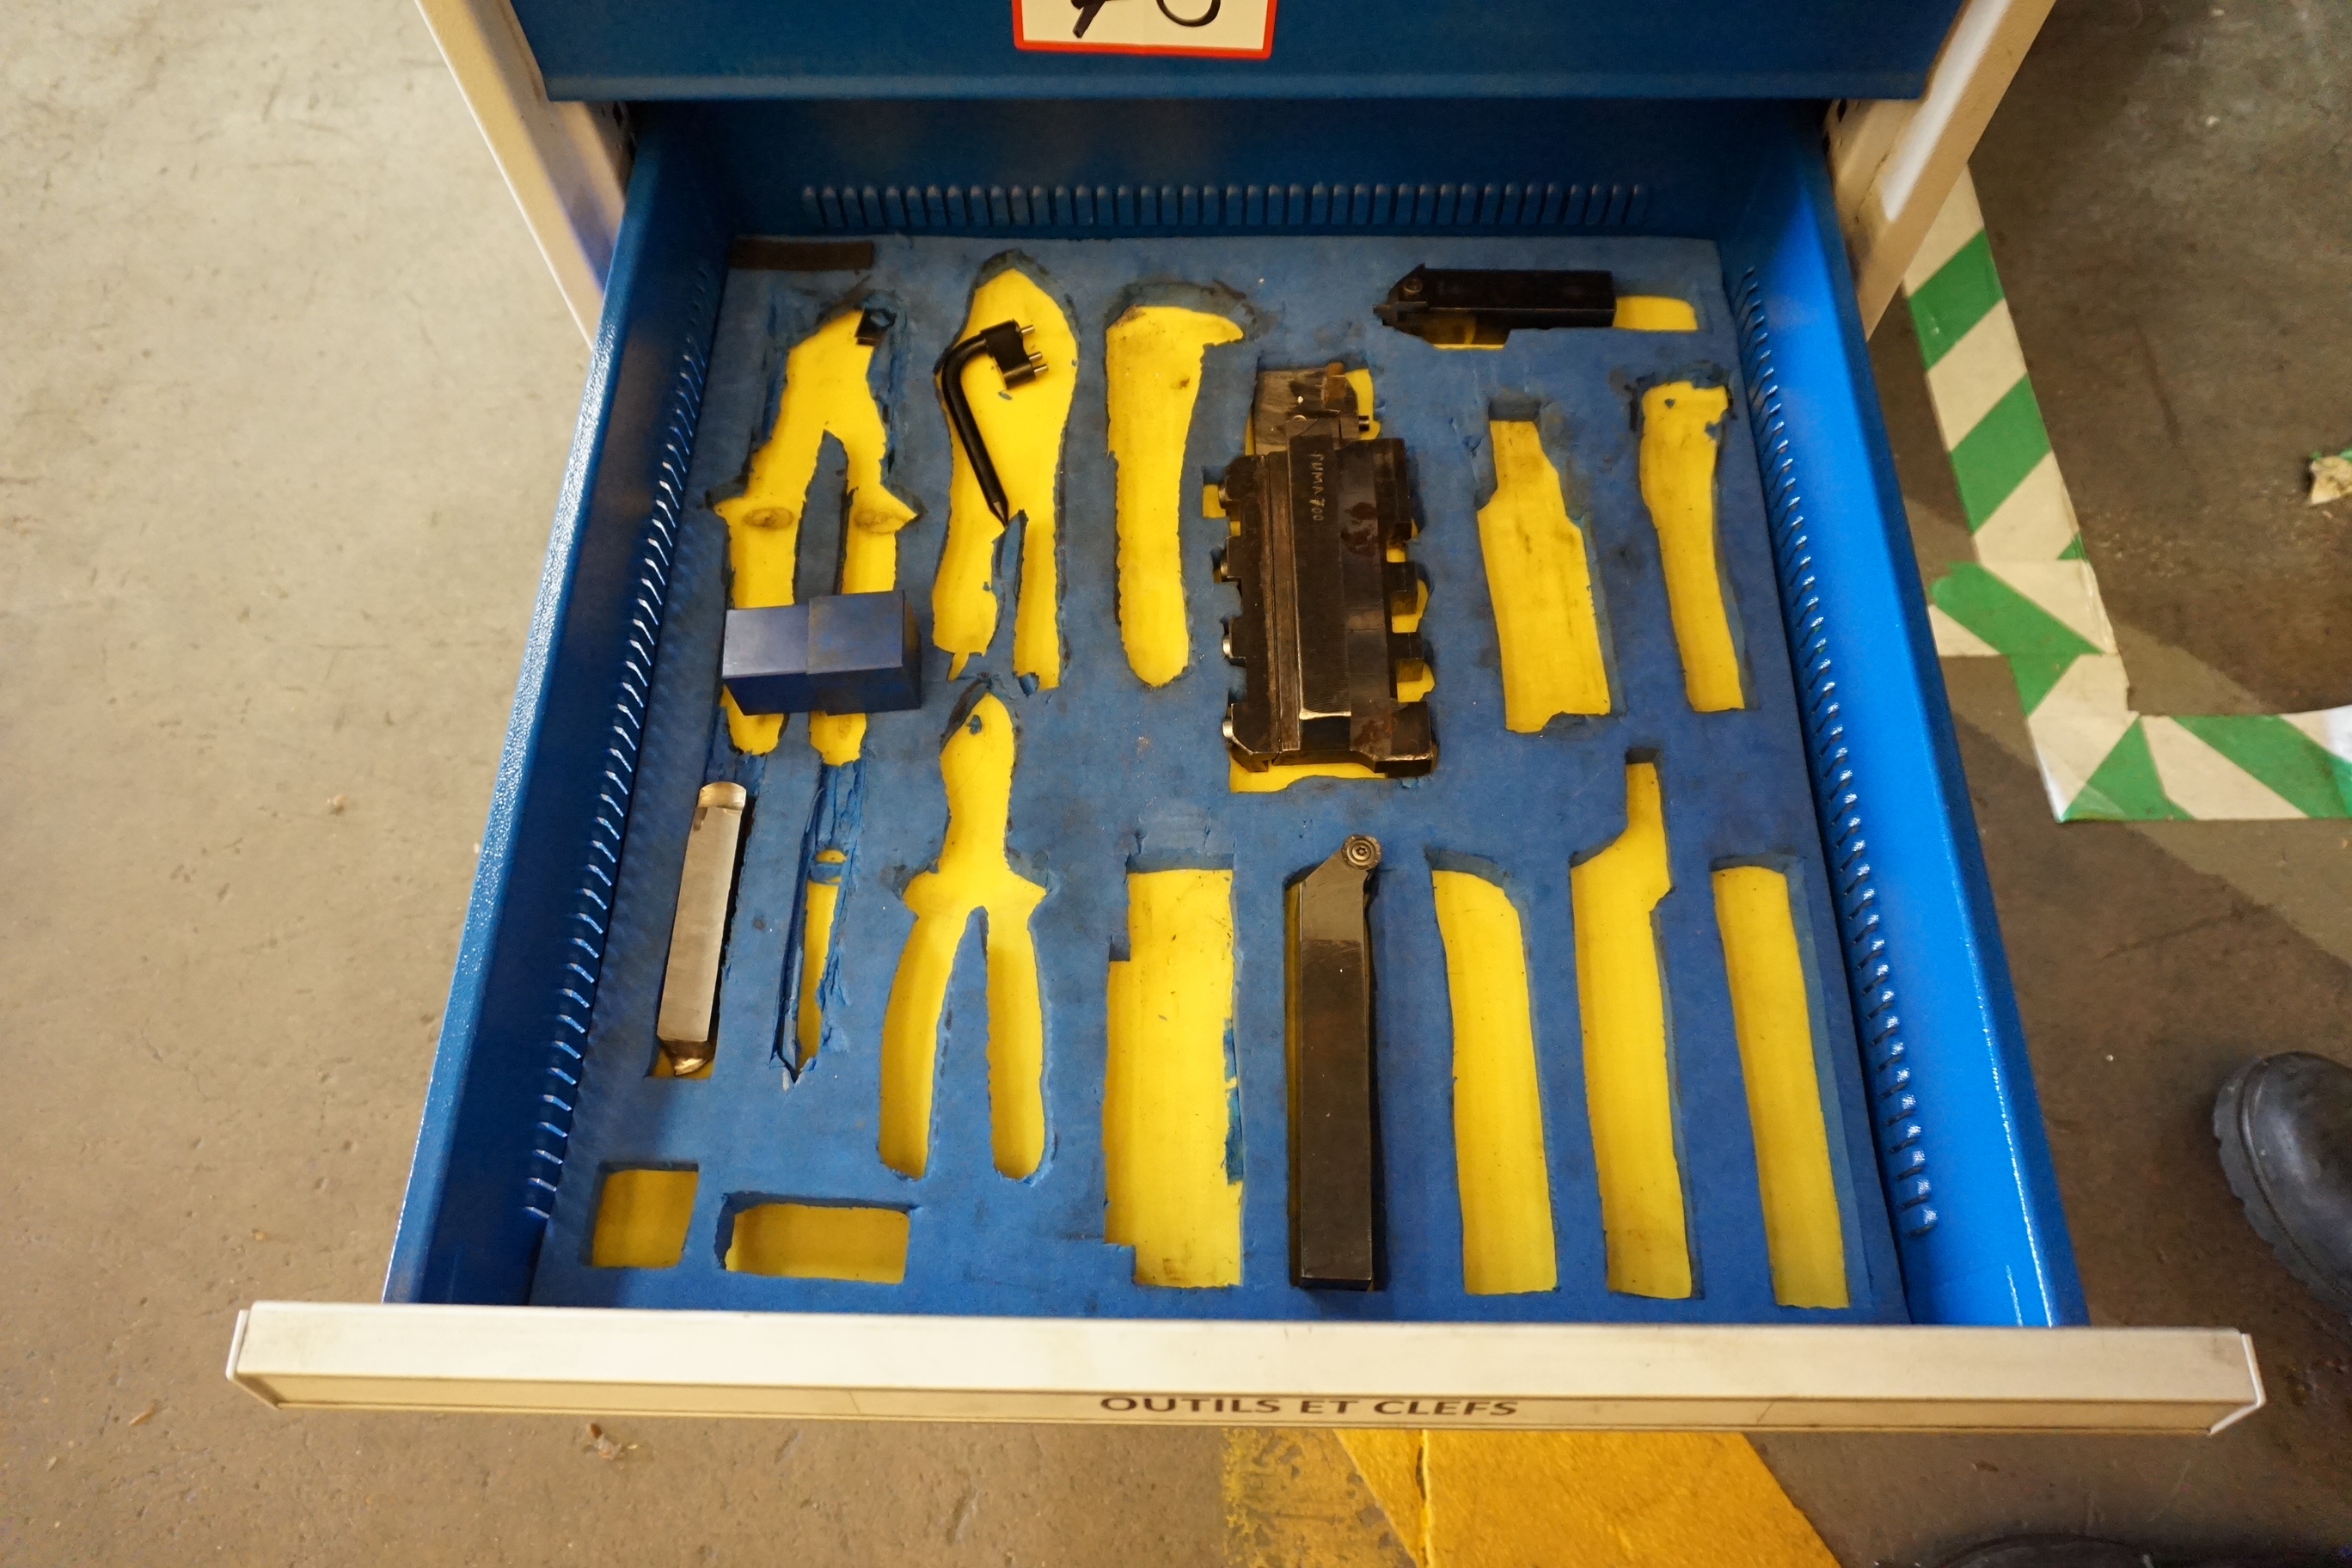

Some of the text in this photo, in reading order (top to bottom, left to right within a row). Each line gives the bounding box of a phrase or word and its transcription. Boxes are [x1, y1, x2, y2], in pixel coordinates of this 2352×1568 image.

[1099, 1397, 1519, 1417] OUTILS ET CLEFS
